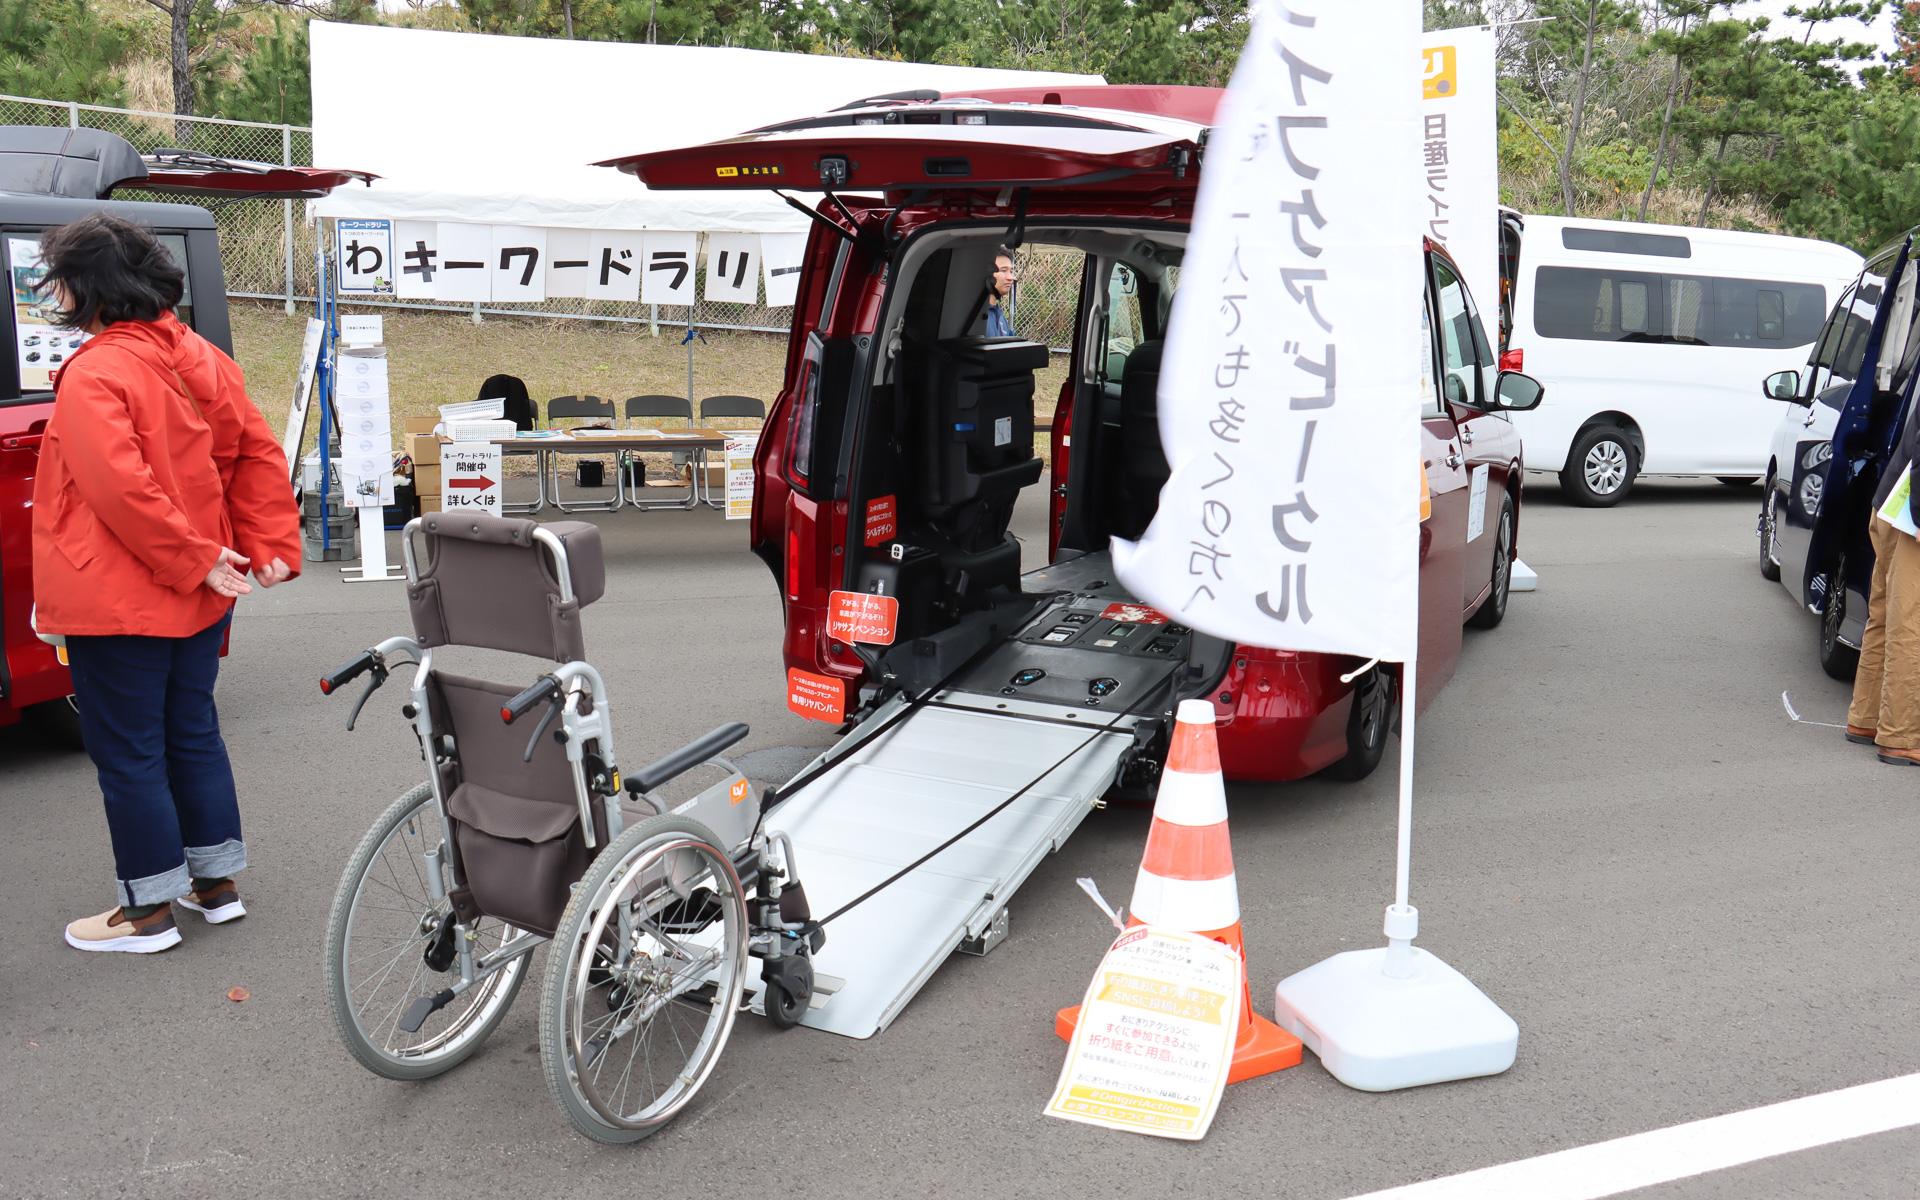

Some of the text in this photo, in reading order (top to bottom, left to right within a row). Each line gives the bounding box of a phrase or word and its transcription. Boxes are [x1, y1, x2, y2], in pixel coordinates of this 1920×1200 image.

[340, 221, 388, 229] キーワードラリー
[345, 239, 383, 275] わ
[403, 240, 802, 291] キーワードラリー
[443, 452, 499, 460] キーワードラリー
[456, 462, 487, 472] 開催中
[447, 494, 496, 506] 詳しくは
[1113, 990, 1206, 1019] SNSに投稿しよう!
[1105, 1022, 1201, 1053] すぐに参加できるように
[1120, 1014, 1190, 1037] おにぎりアクションに
[1088, 1033, 1212, 1070] 折り紙をご用意しています!
[1090, 1089, 1185, 1115] #OnigiriAction
